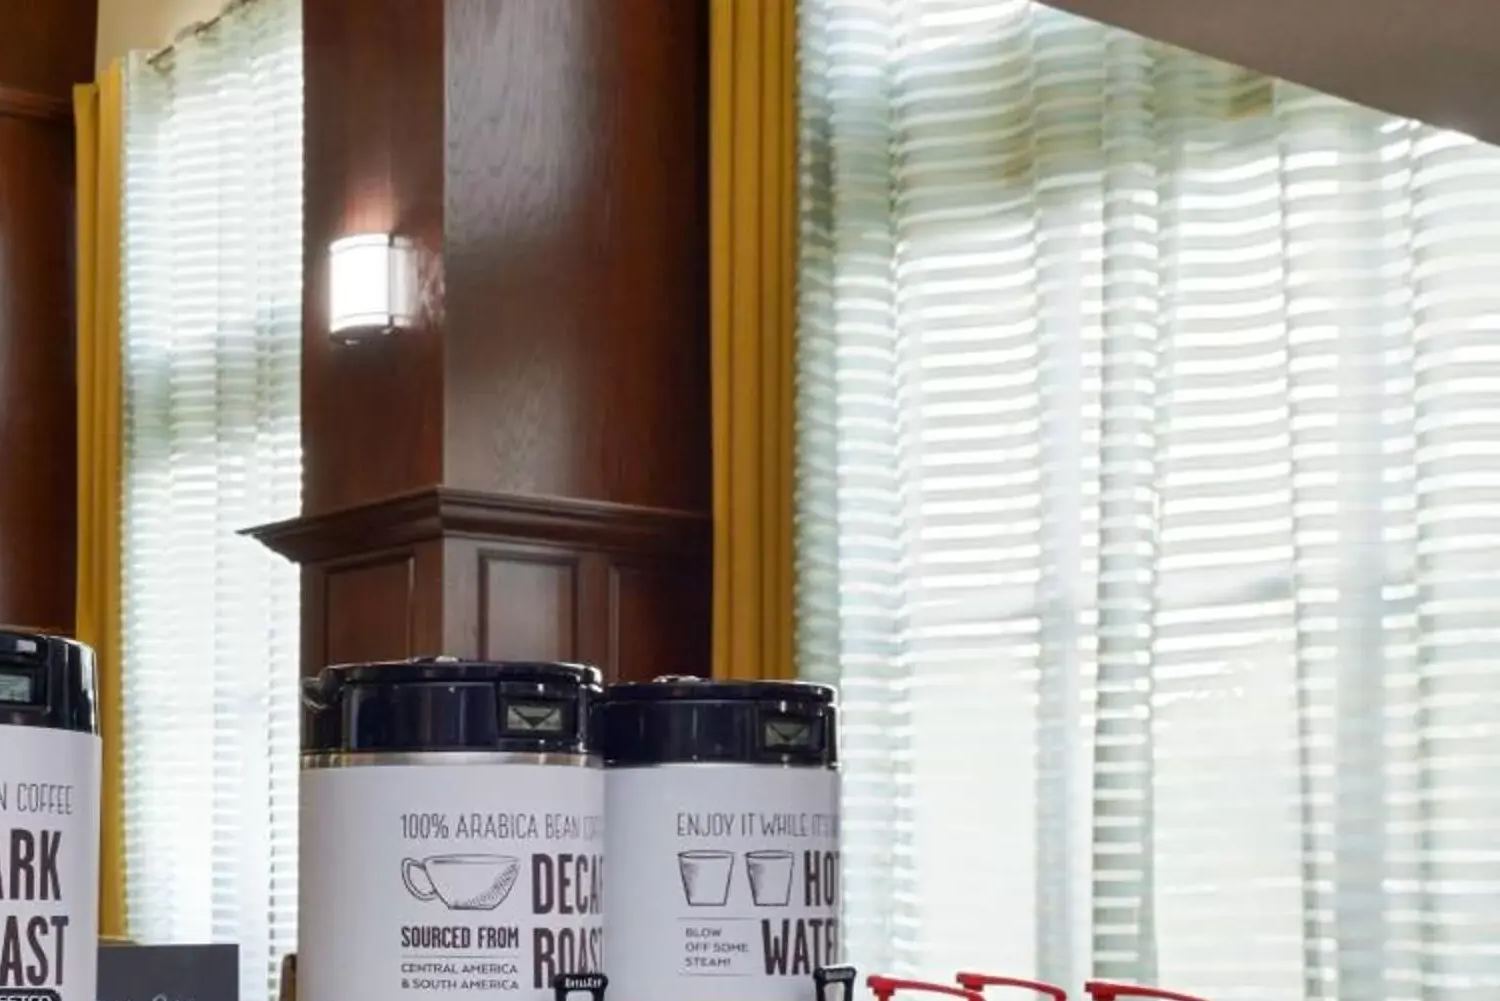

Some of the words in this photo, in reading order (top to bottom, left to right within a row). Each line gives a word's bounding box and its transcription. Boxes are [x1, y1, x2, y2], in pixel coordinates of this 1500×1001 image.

[16, 782, 73, 815] COFFEE
[400, 813, 449, 839] 100%
[455, 813, 539, 839] ARABICA
[545, 813, 580, 840] BEAN
[677, 812, 736, 837] ENJOY
[741, 813, 756, 837] IT
[760, 813, 810, 837] WHILE
[401, 926, 471, 949] SOURCED
[477, 927, 520, 949] FROM
[684, 927, 723, 938] BLOW
[684, 942, 710, 953] OFF
[712, 942, 750, 953] SOME
[401, 962, 459, 974] CENTRAL
[460, 962, 519, 974] AMERICA
[401, 978, 410, 989] &
[412, 978, 457, 990] SOUTH
[460, 979, 520, 990] AMERICA
